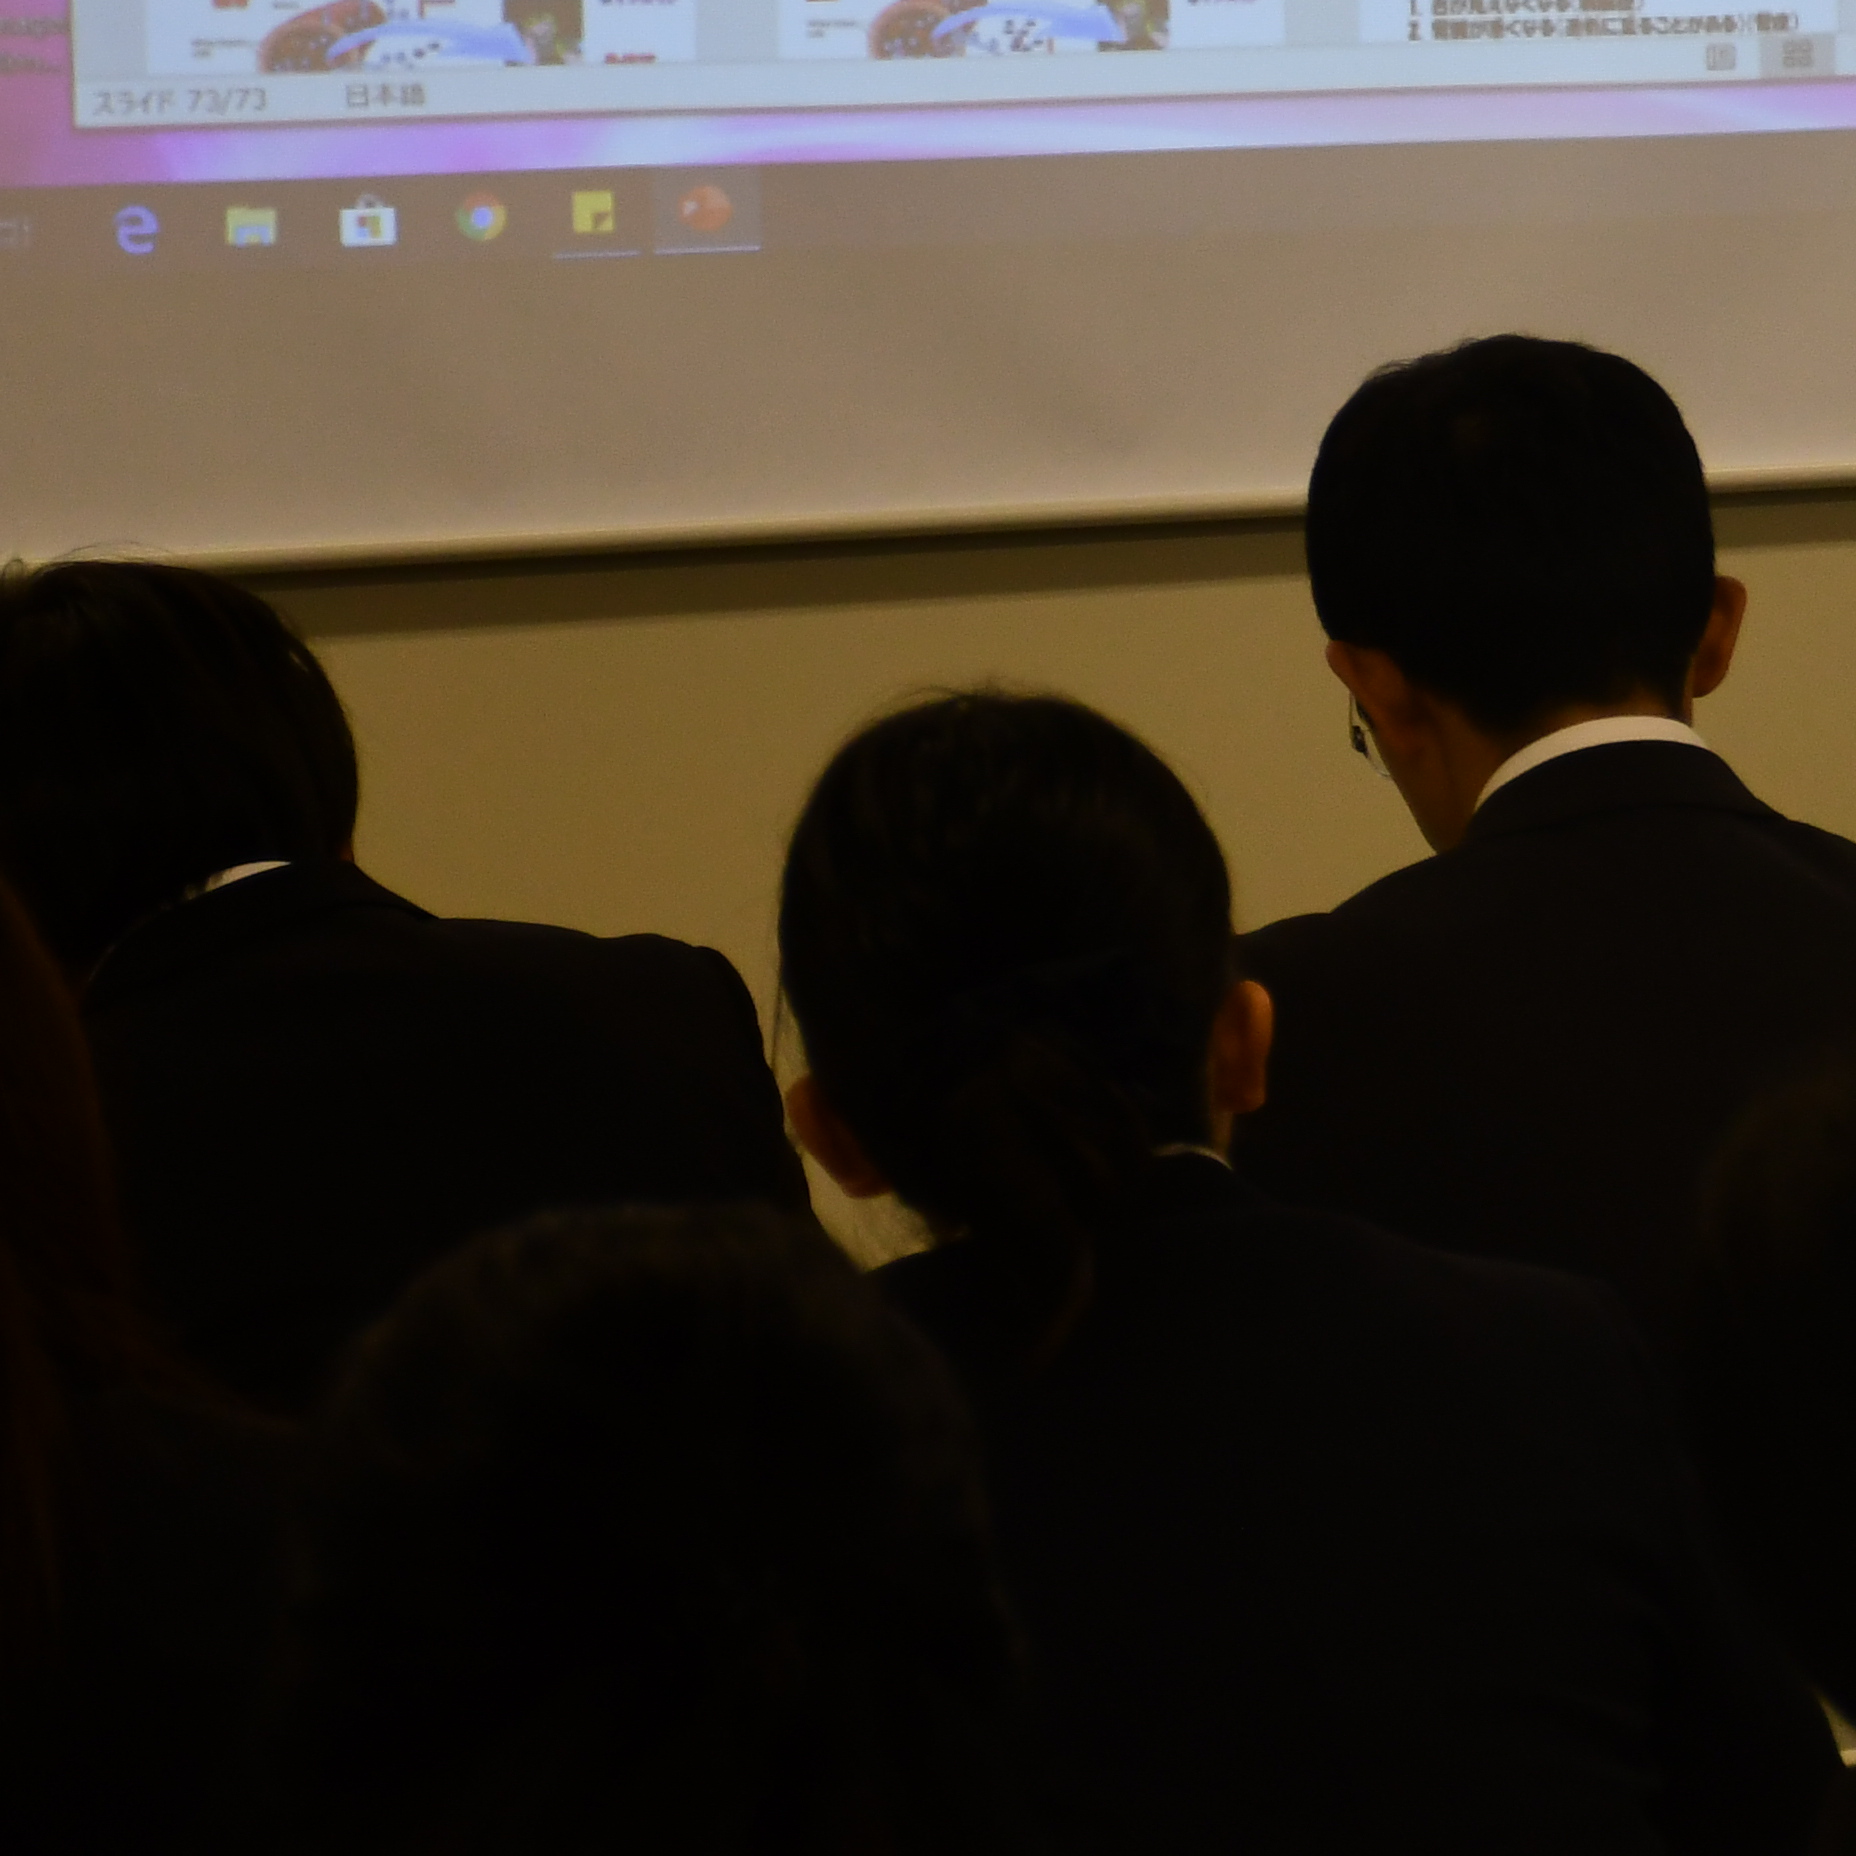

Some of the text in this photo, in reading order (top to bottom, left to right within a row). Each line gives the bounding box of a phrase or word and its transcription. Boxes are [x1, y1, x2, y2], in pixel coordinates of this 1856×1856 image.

[92, 86, 268, 118] スライド 73/73
